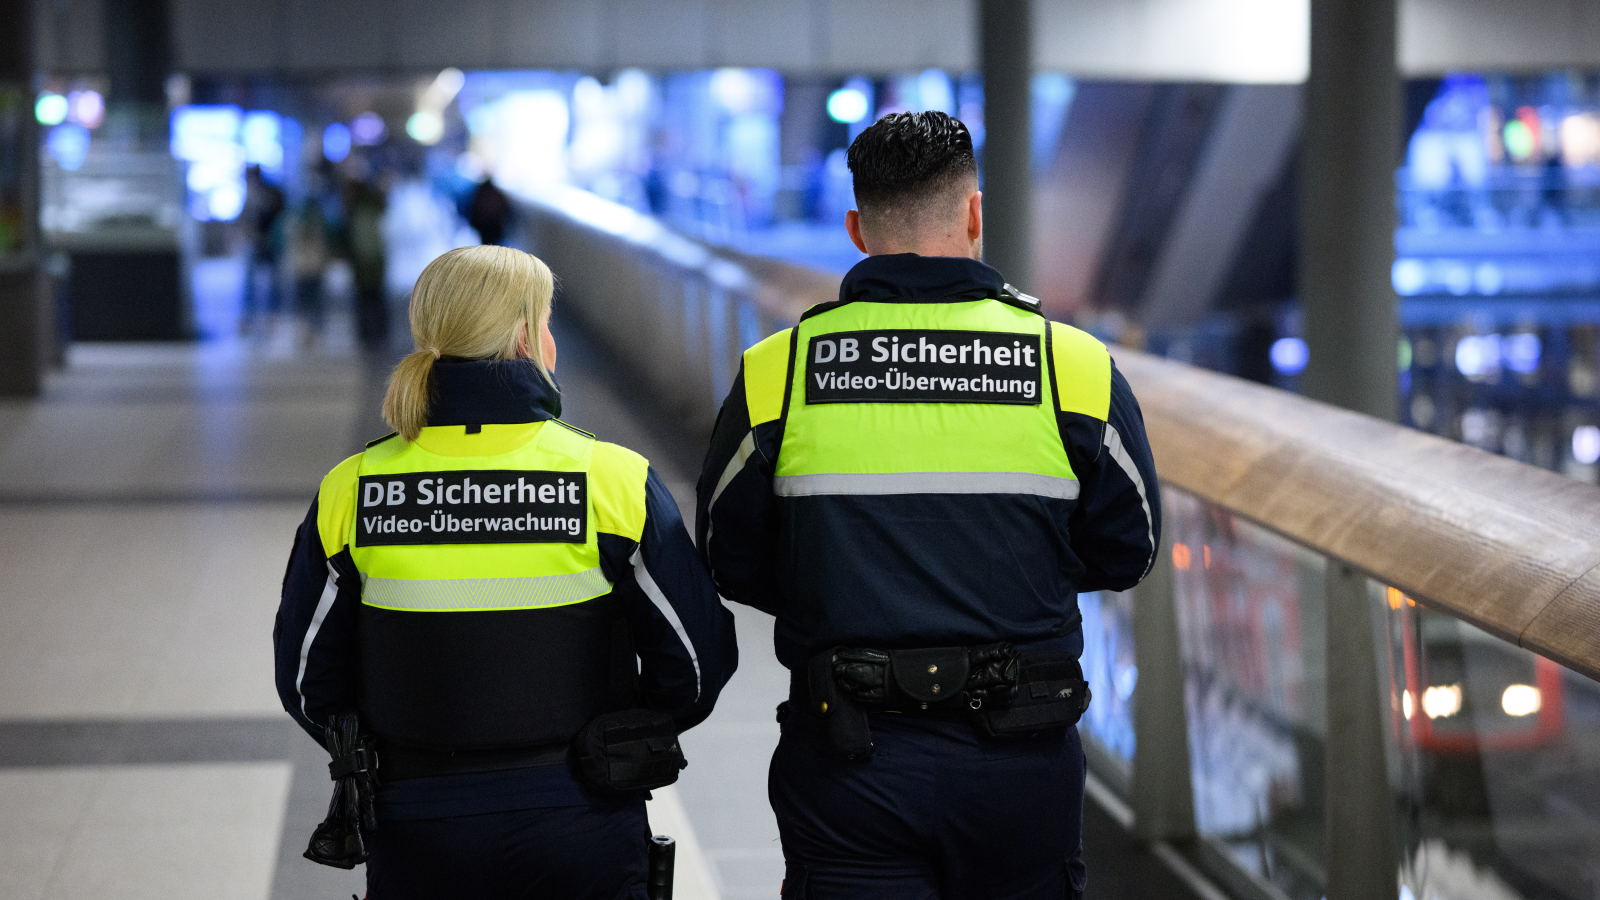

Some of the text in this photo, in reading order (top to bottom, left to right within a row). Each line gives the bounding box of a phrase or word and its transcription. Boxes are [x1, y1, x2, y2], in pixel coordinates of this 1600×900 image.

[815, 336, 1036, 367] DB Sicherheit
[814, 367, 1036, 398] Video-Überwachung
[363, 477, 580, 507] DB Sicherheit
[363, 509, 581, 535] Video-Überwachung
